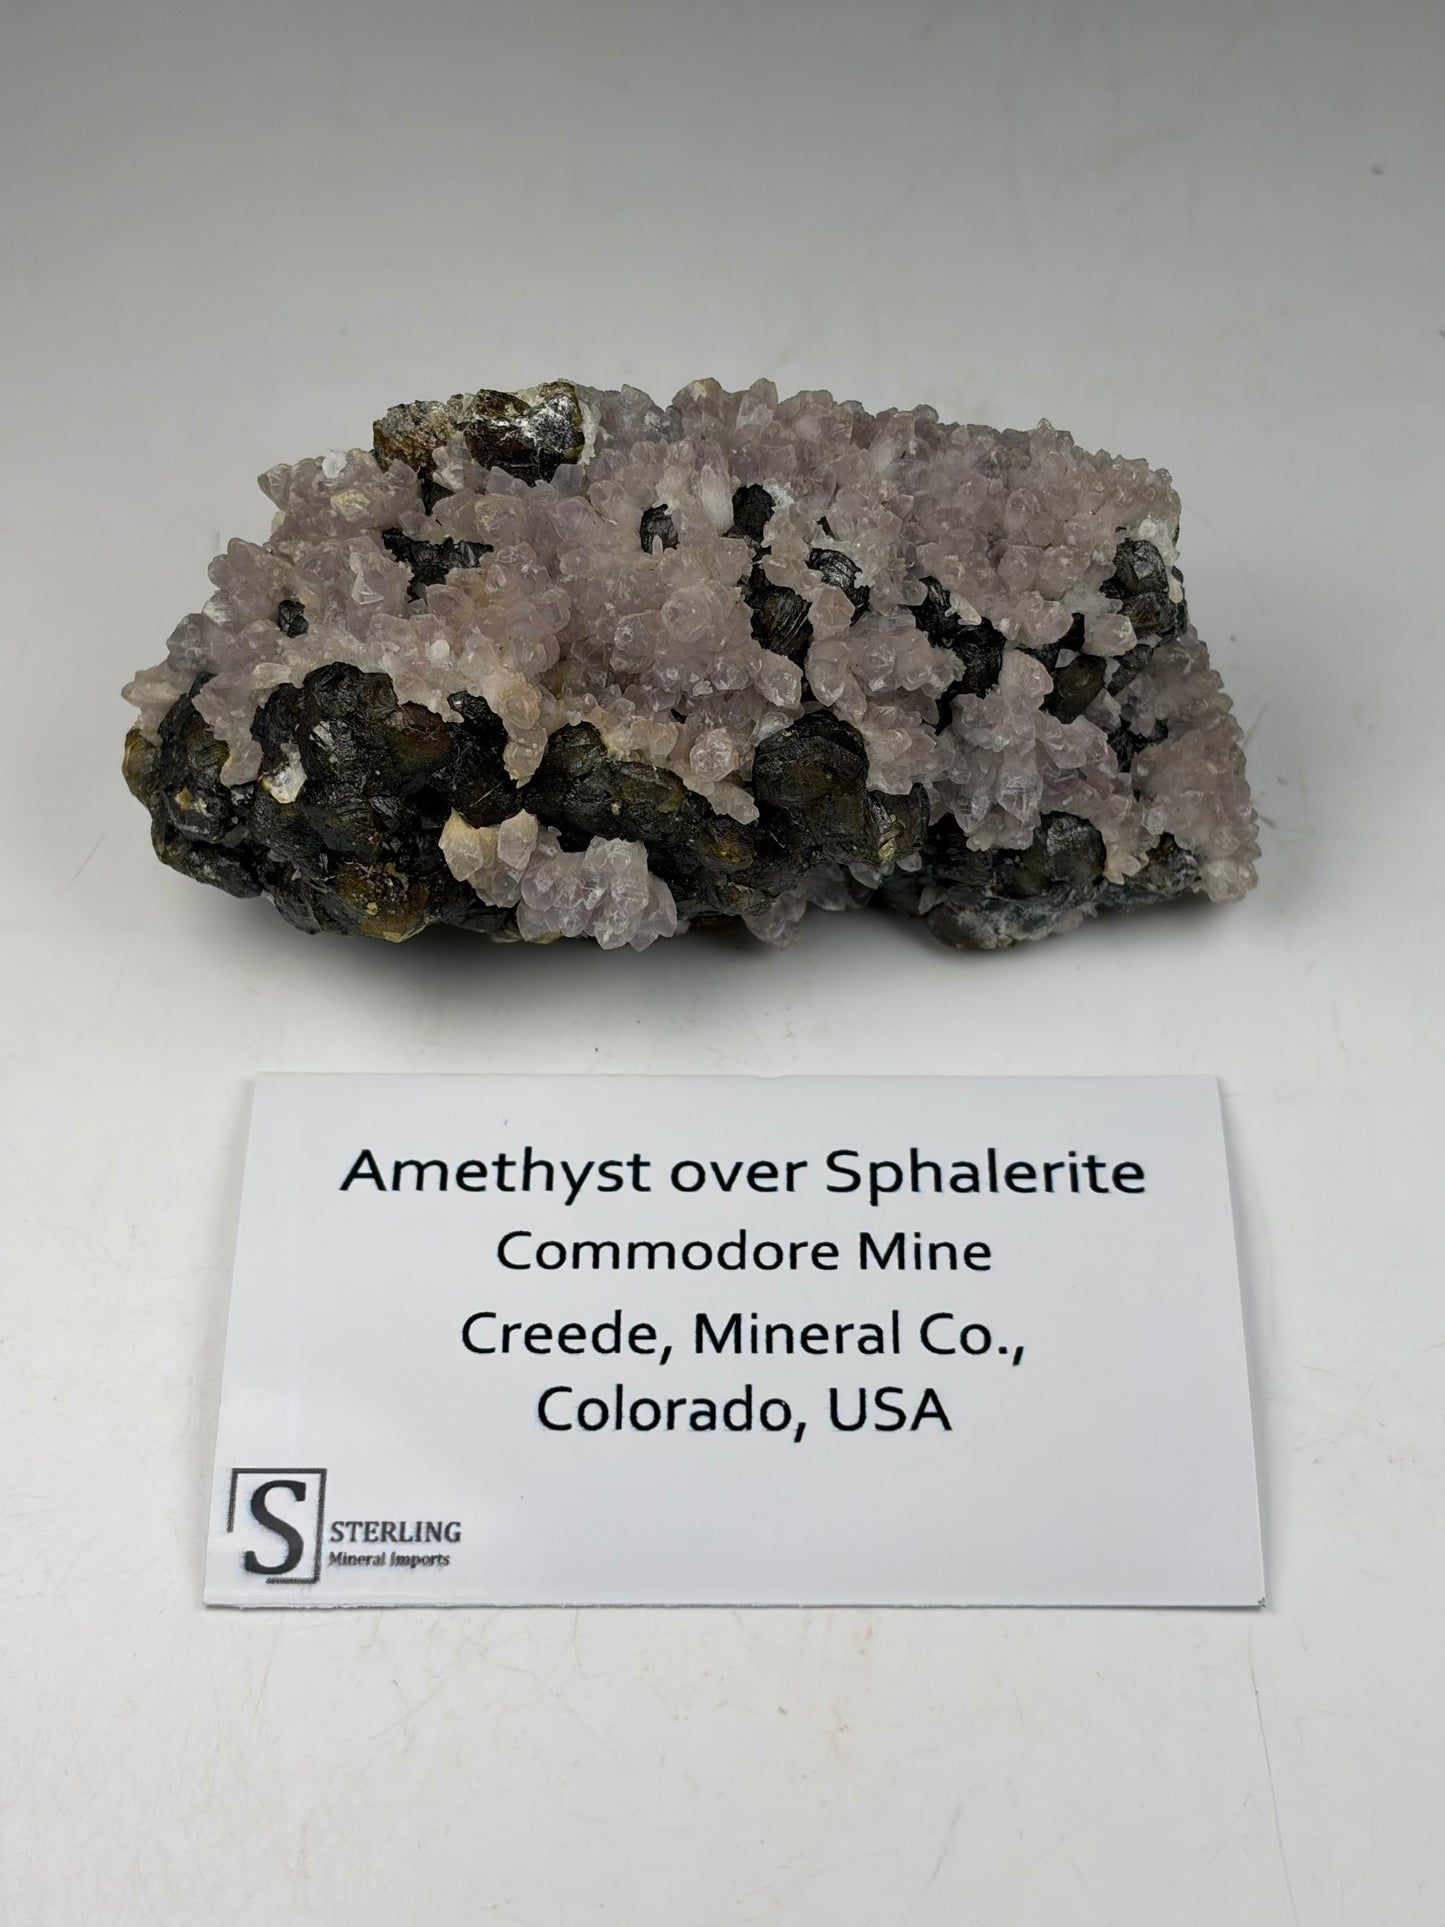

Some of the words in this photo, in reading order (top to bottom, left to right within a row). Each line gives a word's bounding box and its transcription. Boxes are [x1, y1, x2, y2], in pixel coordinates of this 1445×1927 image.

[339, 1146, 652, 1207] Amethyst
[671, 1160, 808, 1193] over
[826, 1147, 1146, 1207] Sphalerite
[497, 1229, 840, 1271] Commodore
[859, 1231, 992, 1272] Mine
[462, 1310, 673, 1366] Creede,
[695, 1309, 900, 1355] Mineral
[919, 1311, 1024, 1367] Co.,
[537, 1384, 807, 1444] Colorado,
[829, 1386, 953, 1432] USA
[244, 1479, 307, 1576] S
[329, 1520, 462, 1543] STERLING
[328, 1551, 386, 1567] Mineral
[390, 1551, 450, 1570] Imports
